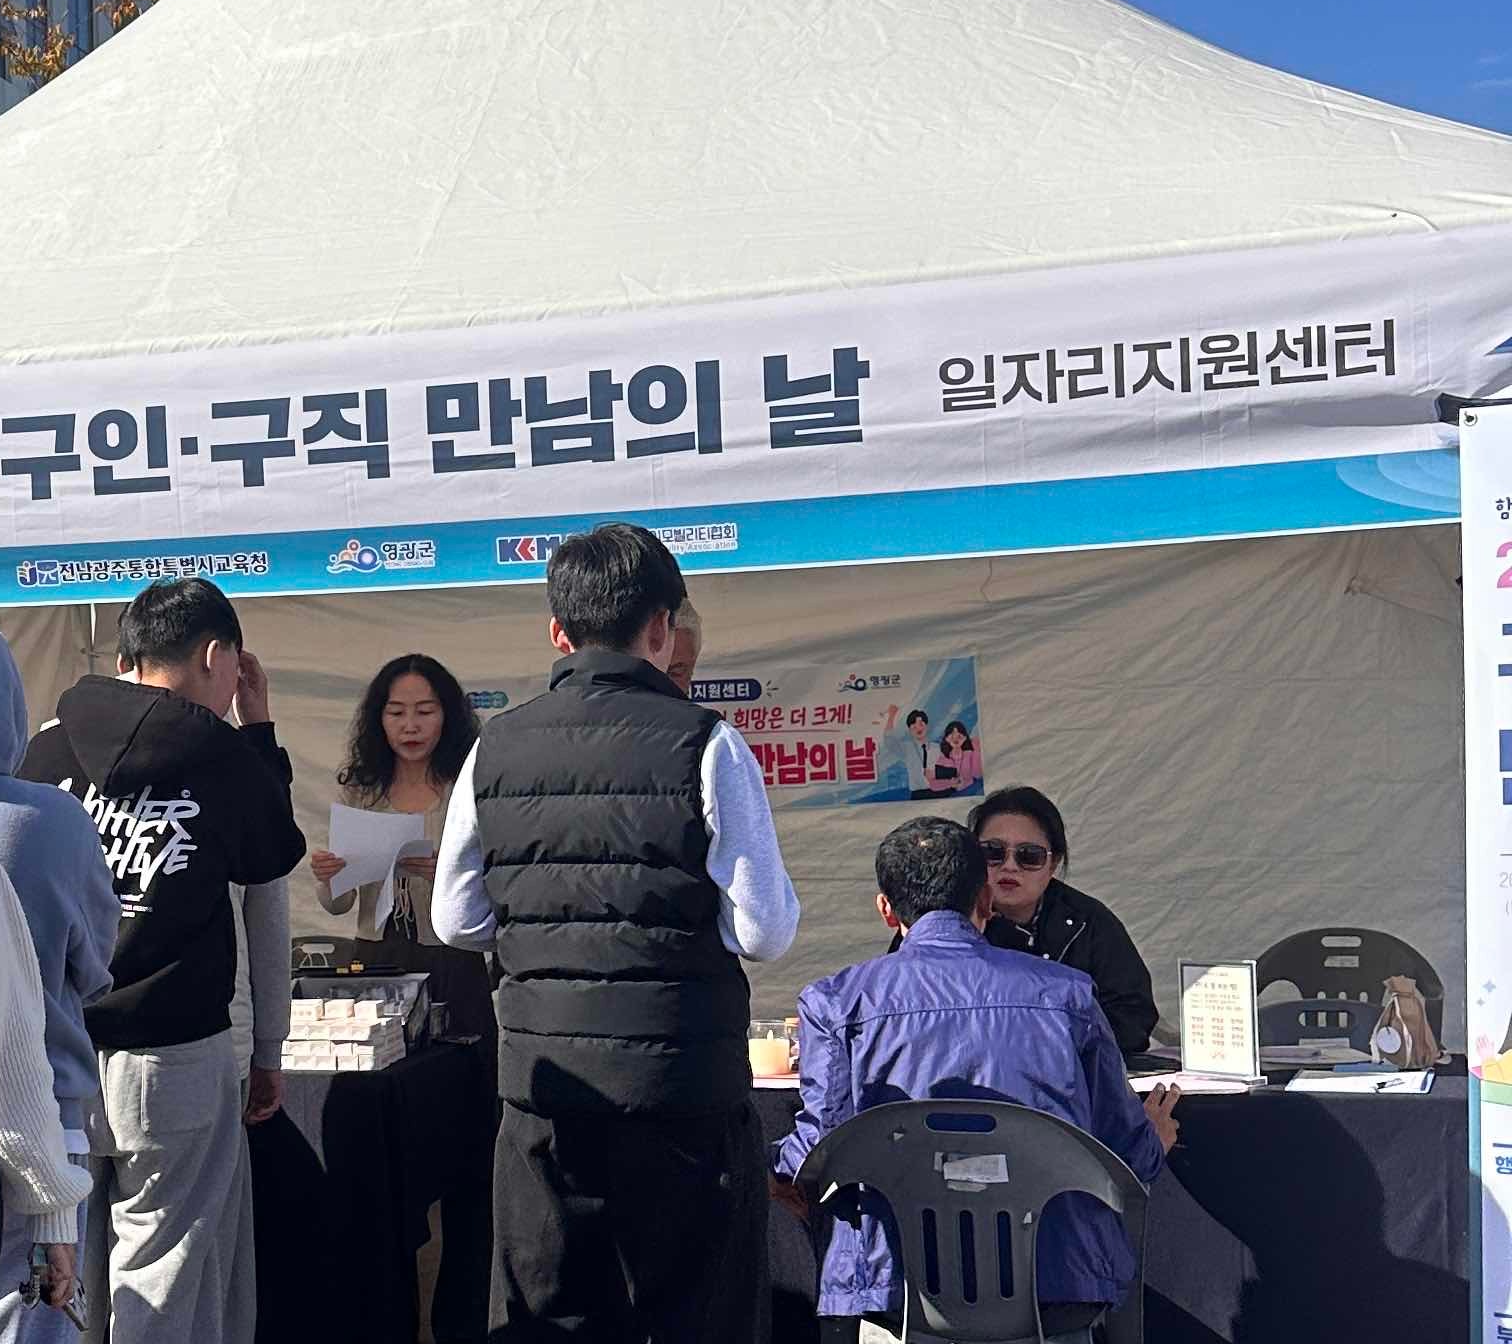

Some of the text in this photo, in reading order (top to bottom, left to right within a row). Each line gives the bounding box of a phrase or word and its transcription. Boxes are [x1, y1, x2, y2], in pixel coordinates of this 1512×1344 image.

[1, 388, 391, 500] 구인·구직
[426, 360, 723, 474] 만남의
[764, 346, 870, 450] 날
[938, 319, 1398, 413] 일자리지원센터
[382, 541, 434, 561] 영광군
[59, 552, 268, 582] 전남광주통합특별시교육청
[687, 682, 751, 700] 지원센터
[734, 706, 784, 730] 희망은
[790, 707, 806, 726] 더
[812, 703, 853, 726] 크게!
[845, 737, 876, 782] 날
